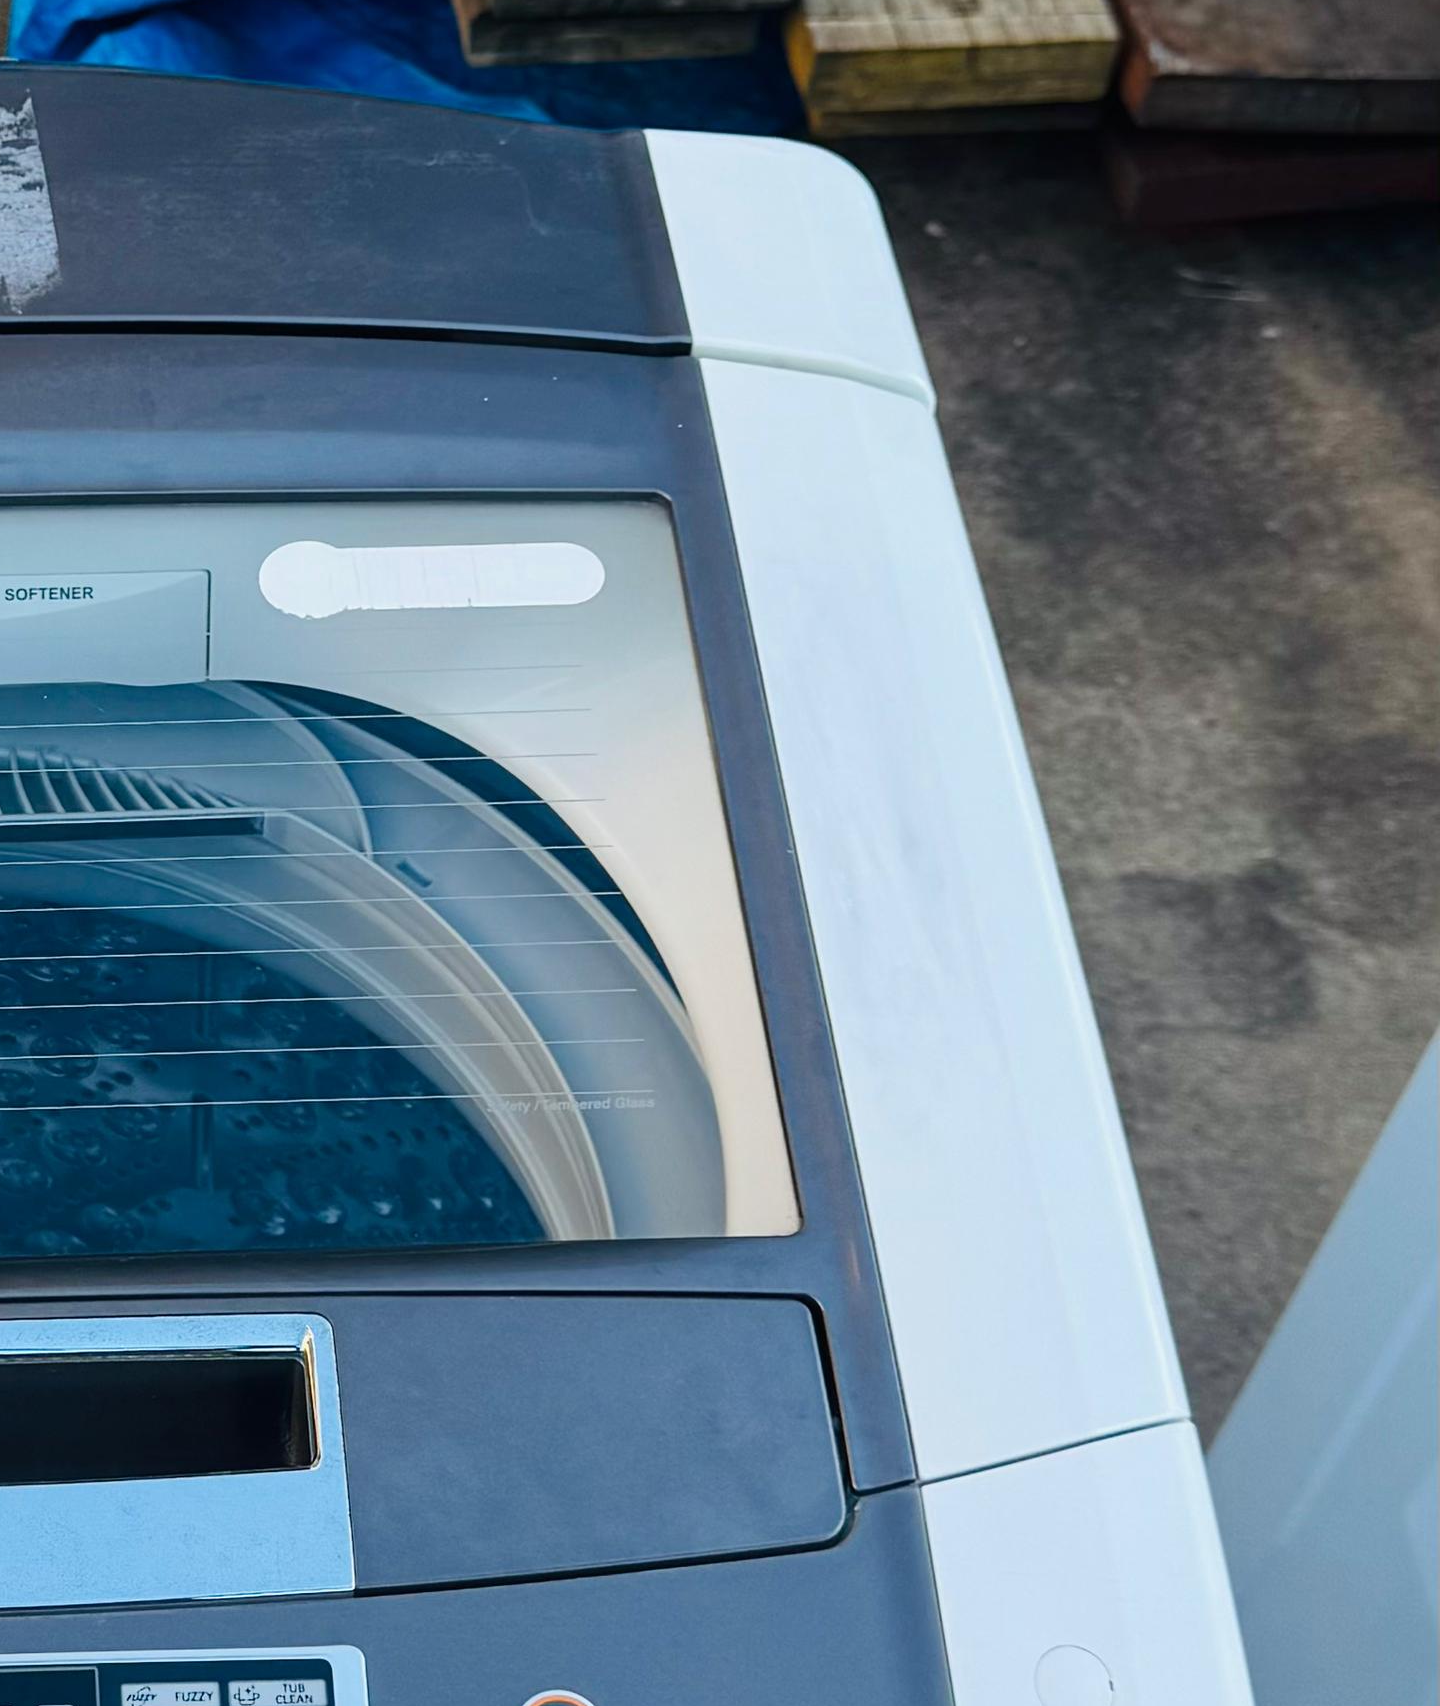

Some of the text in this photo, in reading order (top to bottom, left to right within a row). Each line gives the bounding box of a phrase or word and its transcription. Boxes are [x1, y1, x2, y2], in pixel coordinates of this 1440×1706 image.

[4, 586, 94, 602] SOFTENER
[615, 1096, 656, 1110] Glass
[282, 1683, 306, 1694] TUB
[174, 1691, 214, 1703] FUZZY
[275, 1694, 314, 1705] CLEAN
